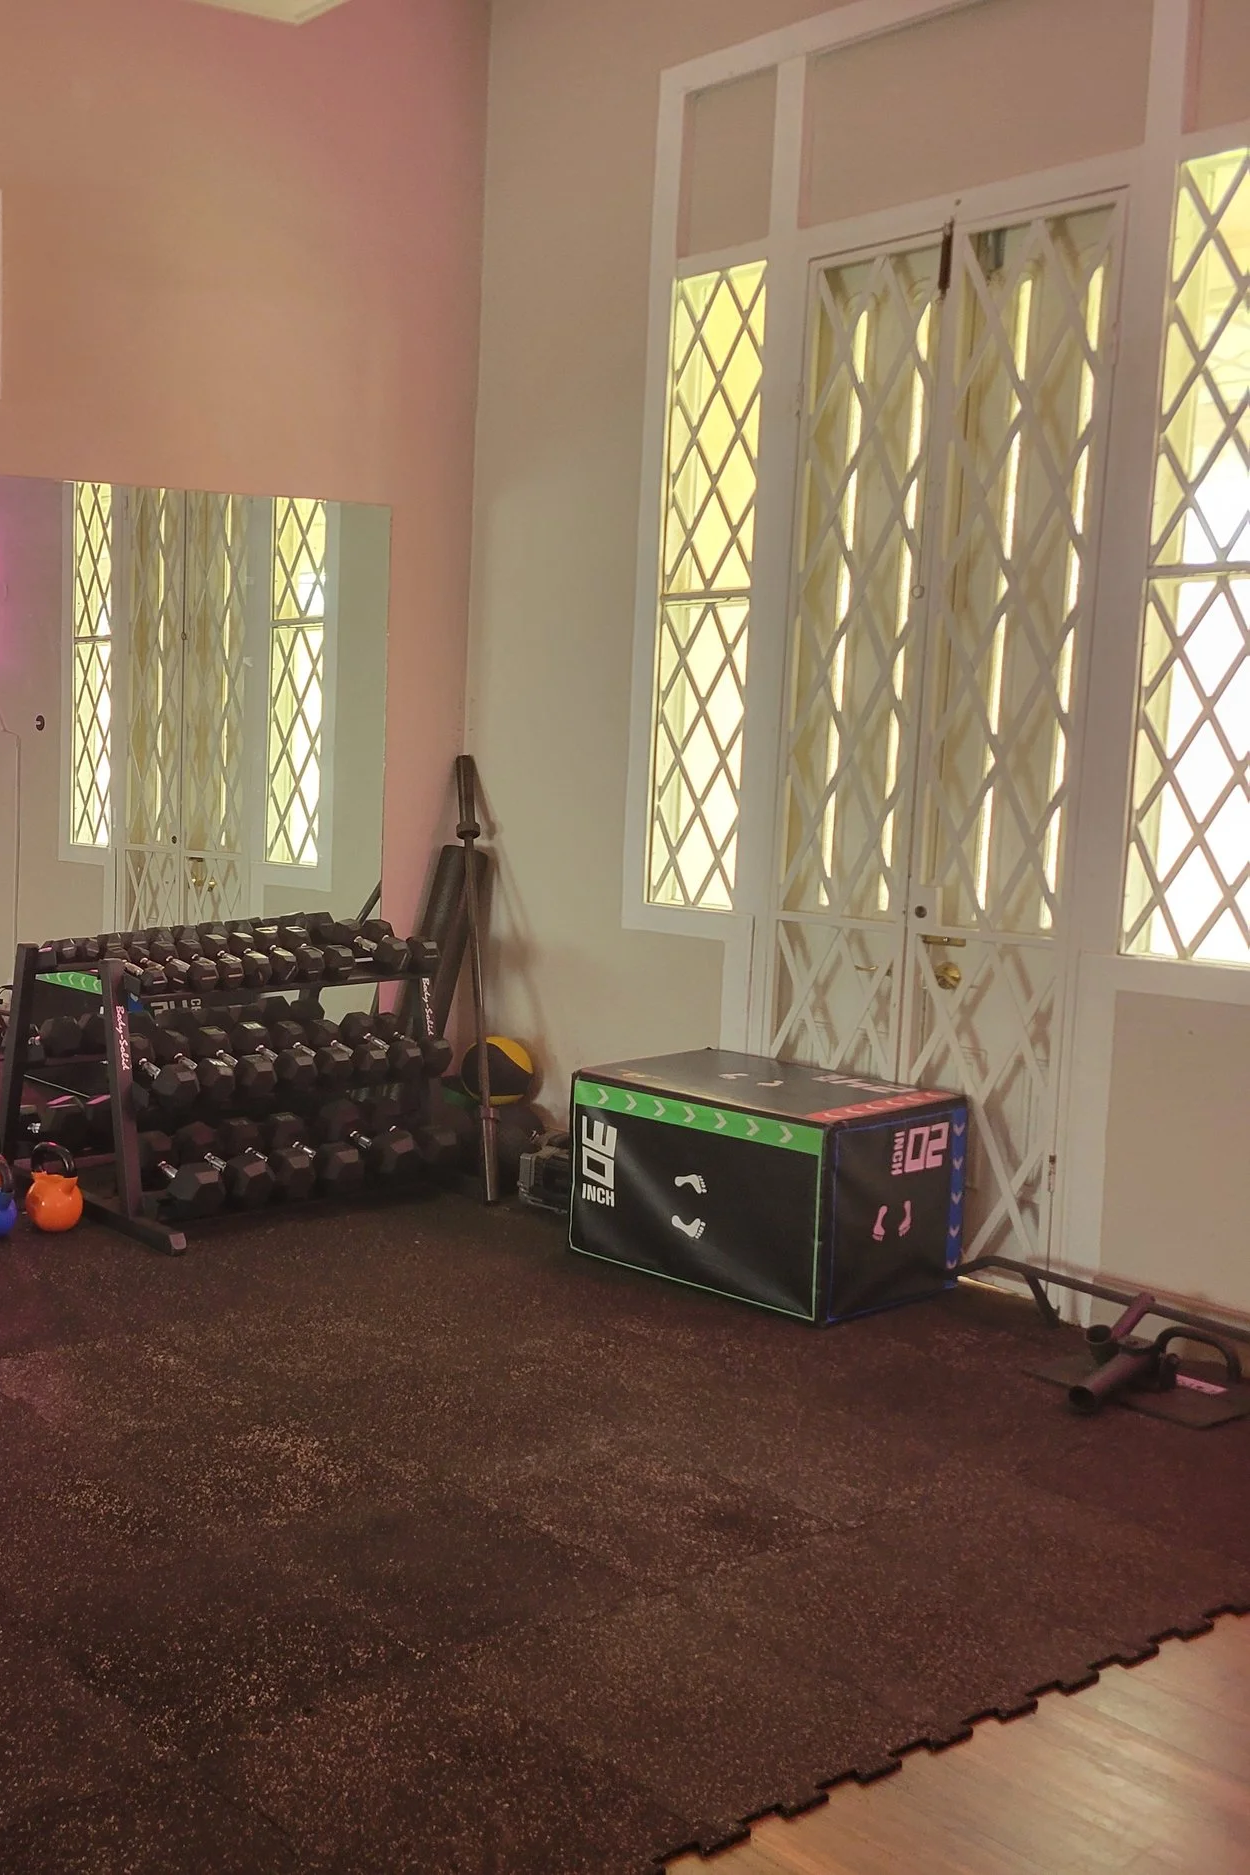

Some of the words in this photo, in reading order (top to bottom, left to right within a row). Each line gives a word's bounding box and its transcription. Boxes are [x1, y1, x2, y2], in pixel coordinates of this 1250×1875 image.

[115, 1005, 130, 1071] Body-Solid
[891, 1131, 906, 1176] INCH
[581, 1182, 615, 1208] INCH
